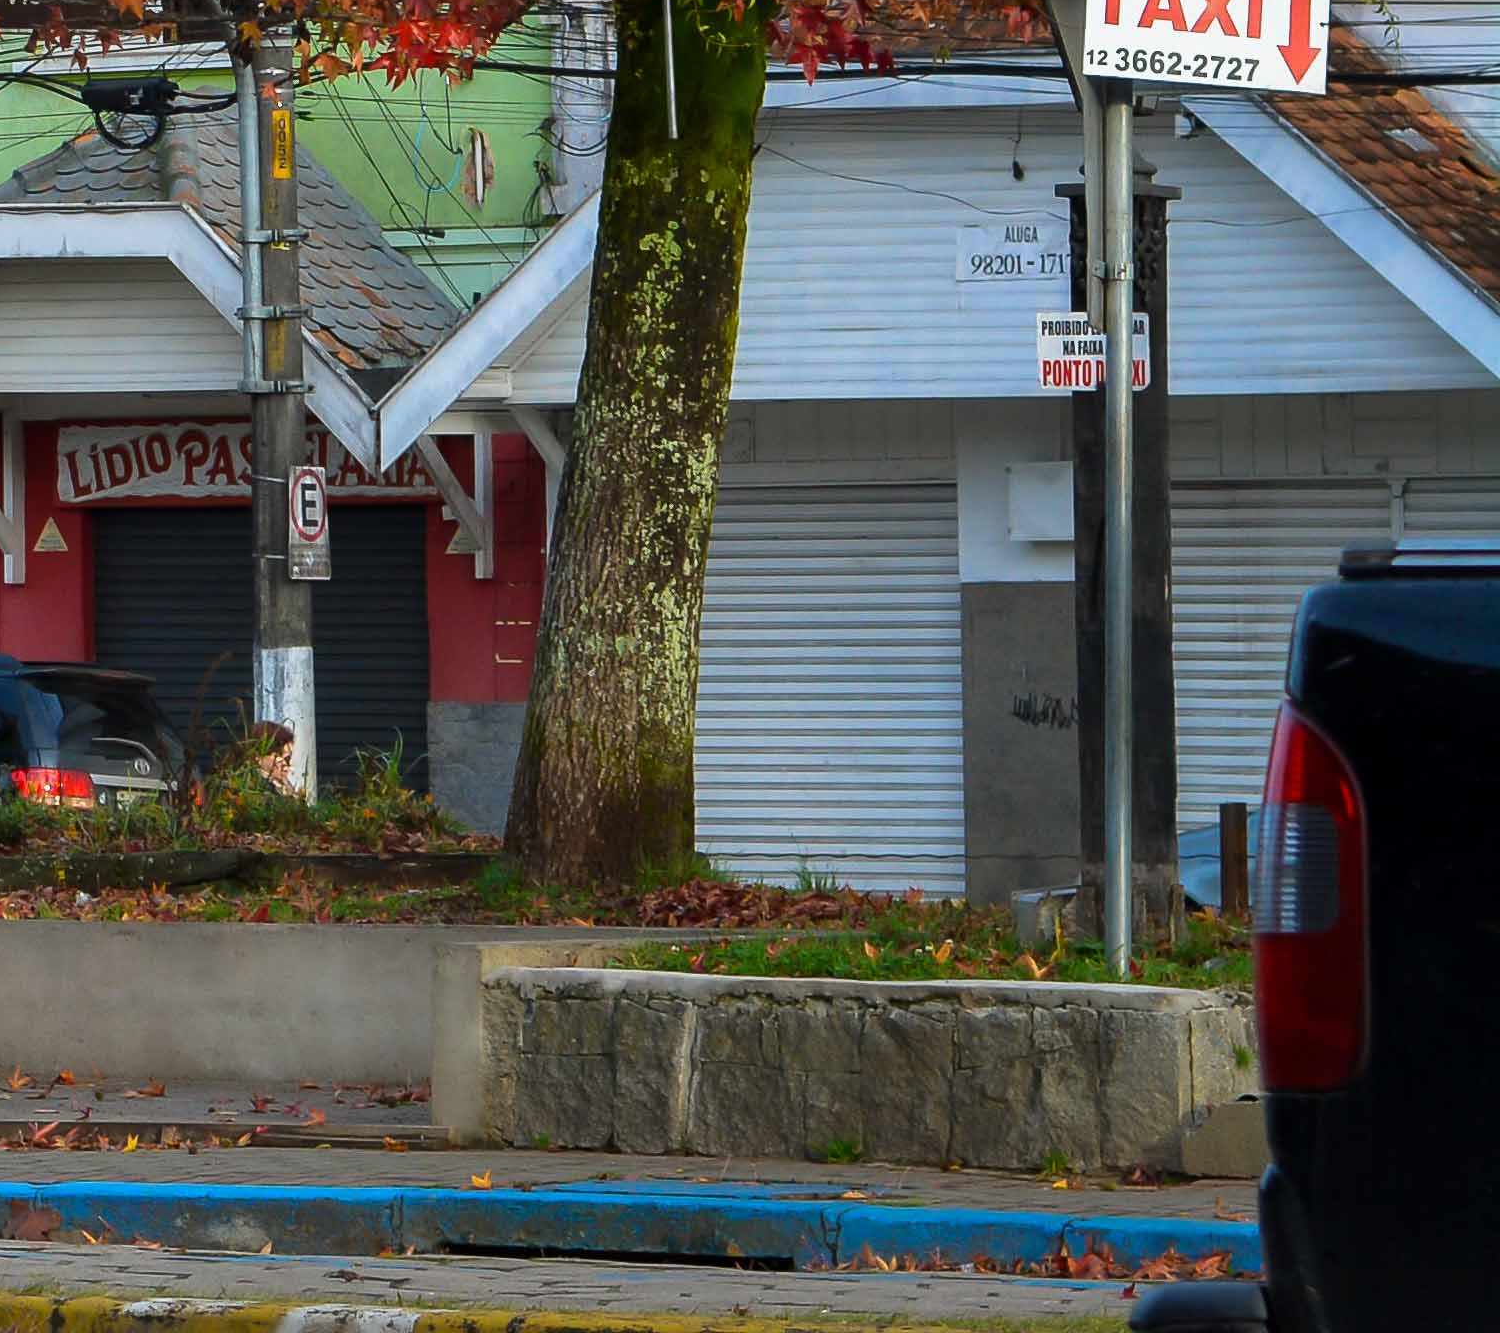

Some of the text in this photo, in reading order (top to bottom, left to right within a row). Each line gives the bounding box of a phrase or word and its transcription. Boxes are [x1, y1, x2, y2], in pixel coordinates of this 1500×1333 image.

[1086, 47, 1260, 82] 12 3662-2727
[1004, 225, 1039, 243] ALUGA
[971, 253, 1022, 276] 98201
[1041, 320, 1089, 336] PROIBIDO
[1062, 340, 1104, 355] NA FAIXA
[1043, 360, 1092, 387] PONTO
[1132, 360, 1146, 387] XI
[64, 430, 172, 499] LÍDIO
[300, 482, 319, 528] E
